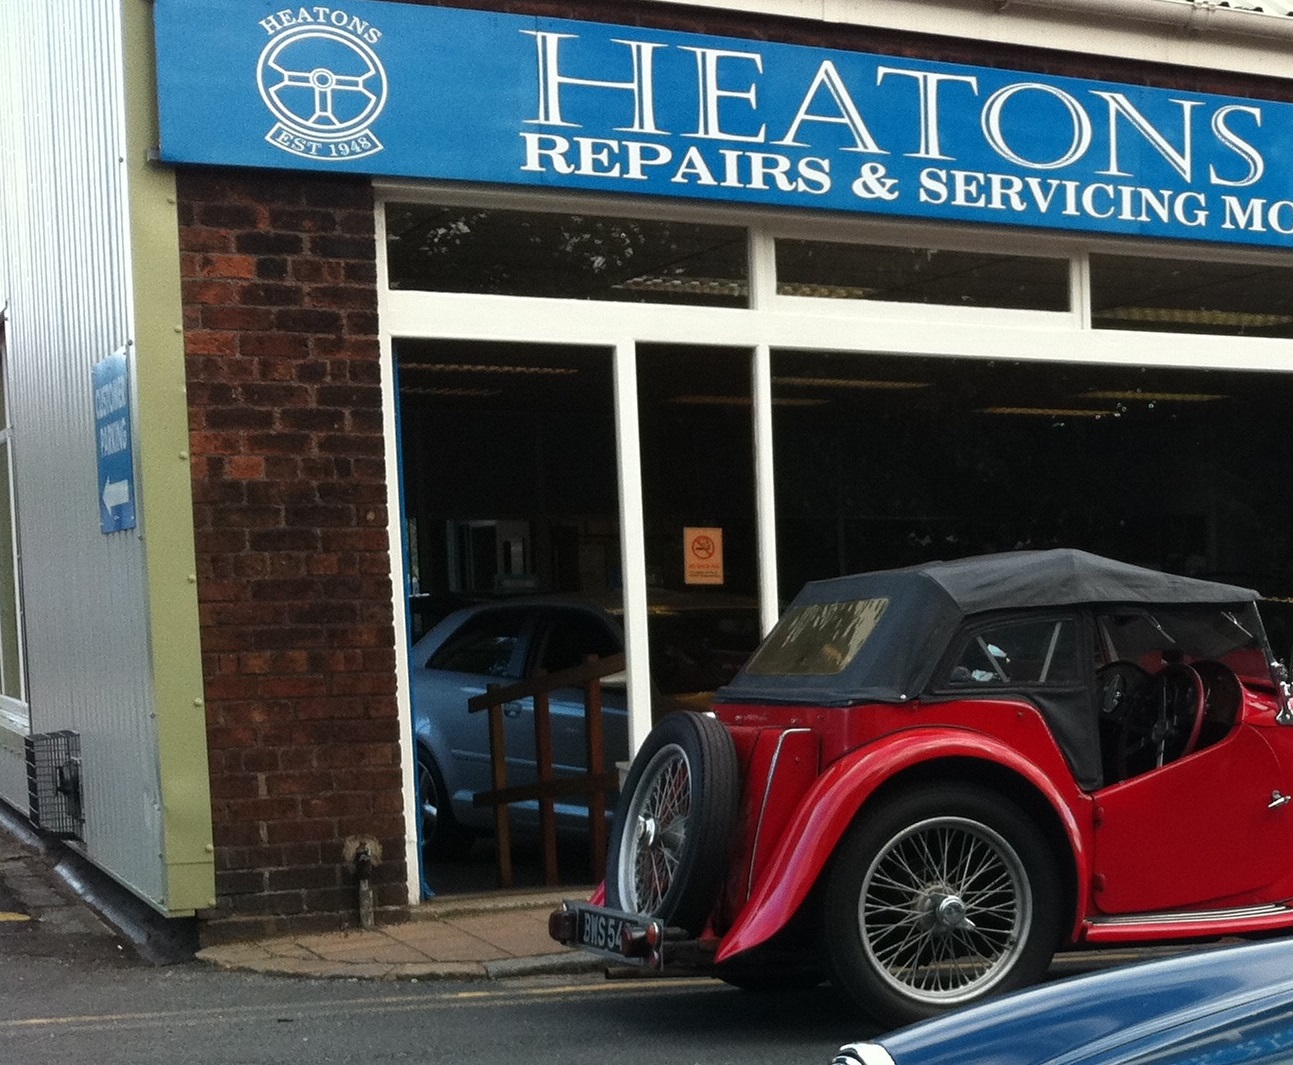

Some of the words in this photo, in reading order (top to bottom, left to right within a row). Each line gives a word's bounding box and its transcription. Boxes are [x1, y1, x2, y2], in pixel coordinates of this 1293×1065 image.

[258, 6, 383, 44] HEATONS
[518, 29, 1265, 187] HEATONS
[275, 130, 323, 156] EST
[328, 136, 373, 157] 1948
[519, 131, 832, 195] REPAIRS
[851, 162, 899, 201] &
[919, 167, 1209, 227] SERVICING
[100, 417, 127, 458] PARKING
[583, 912, 606, 946] BMS
[607, 918, 624, 951] 54
